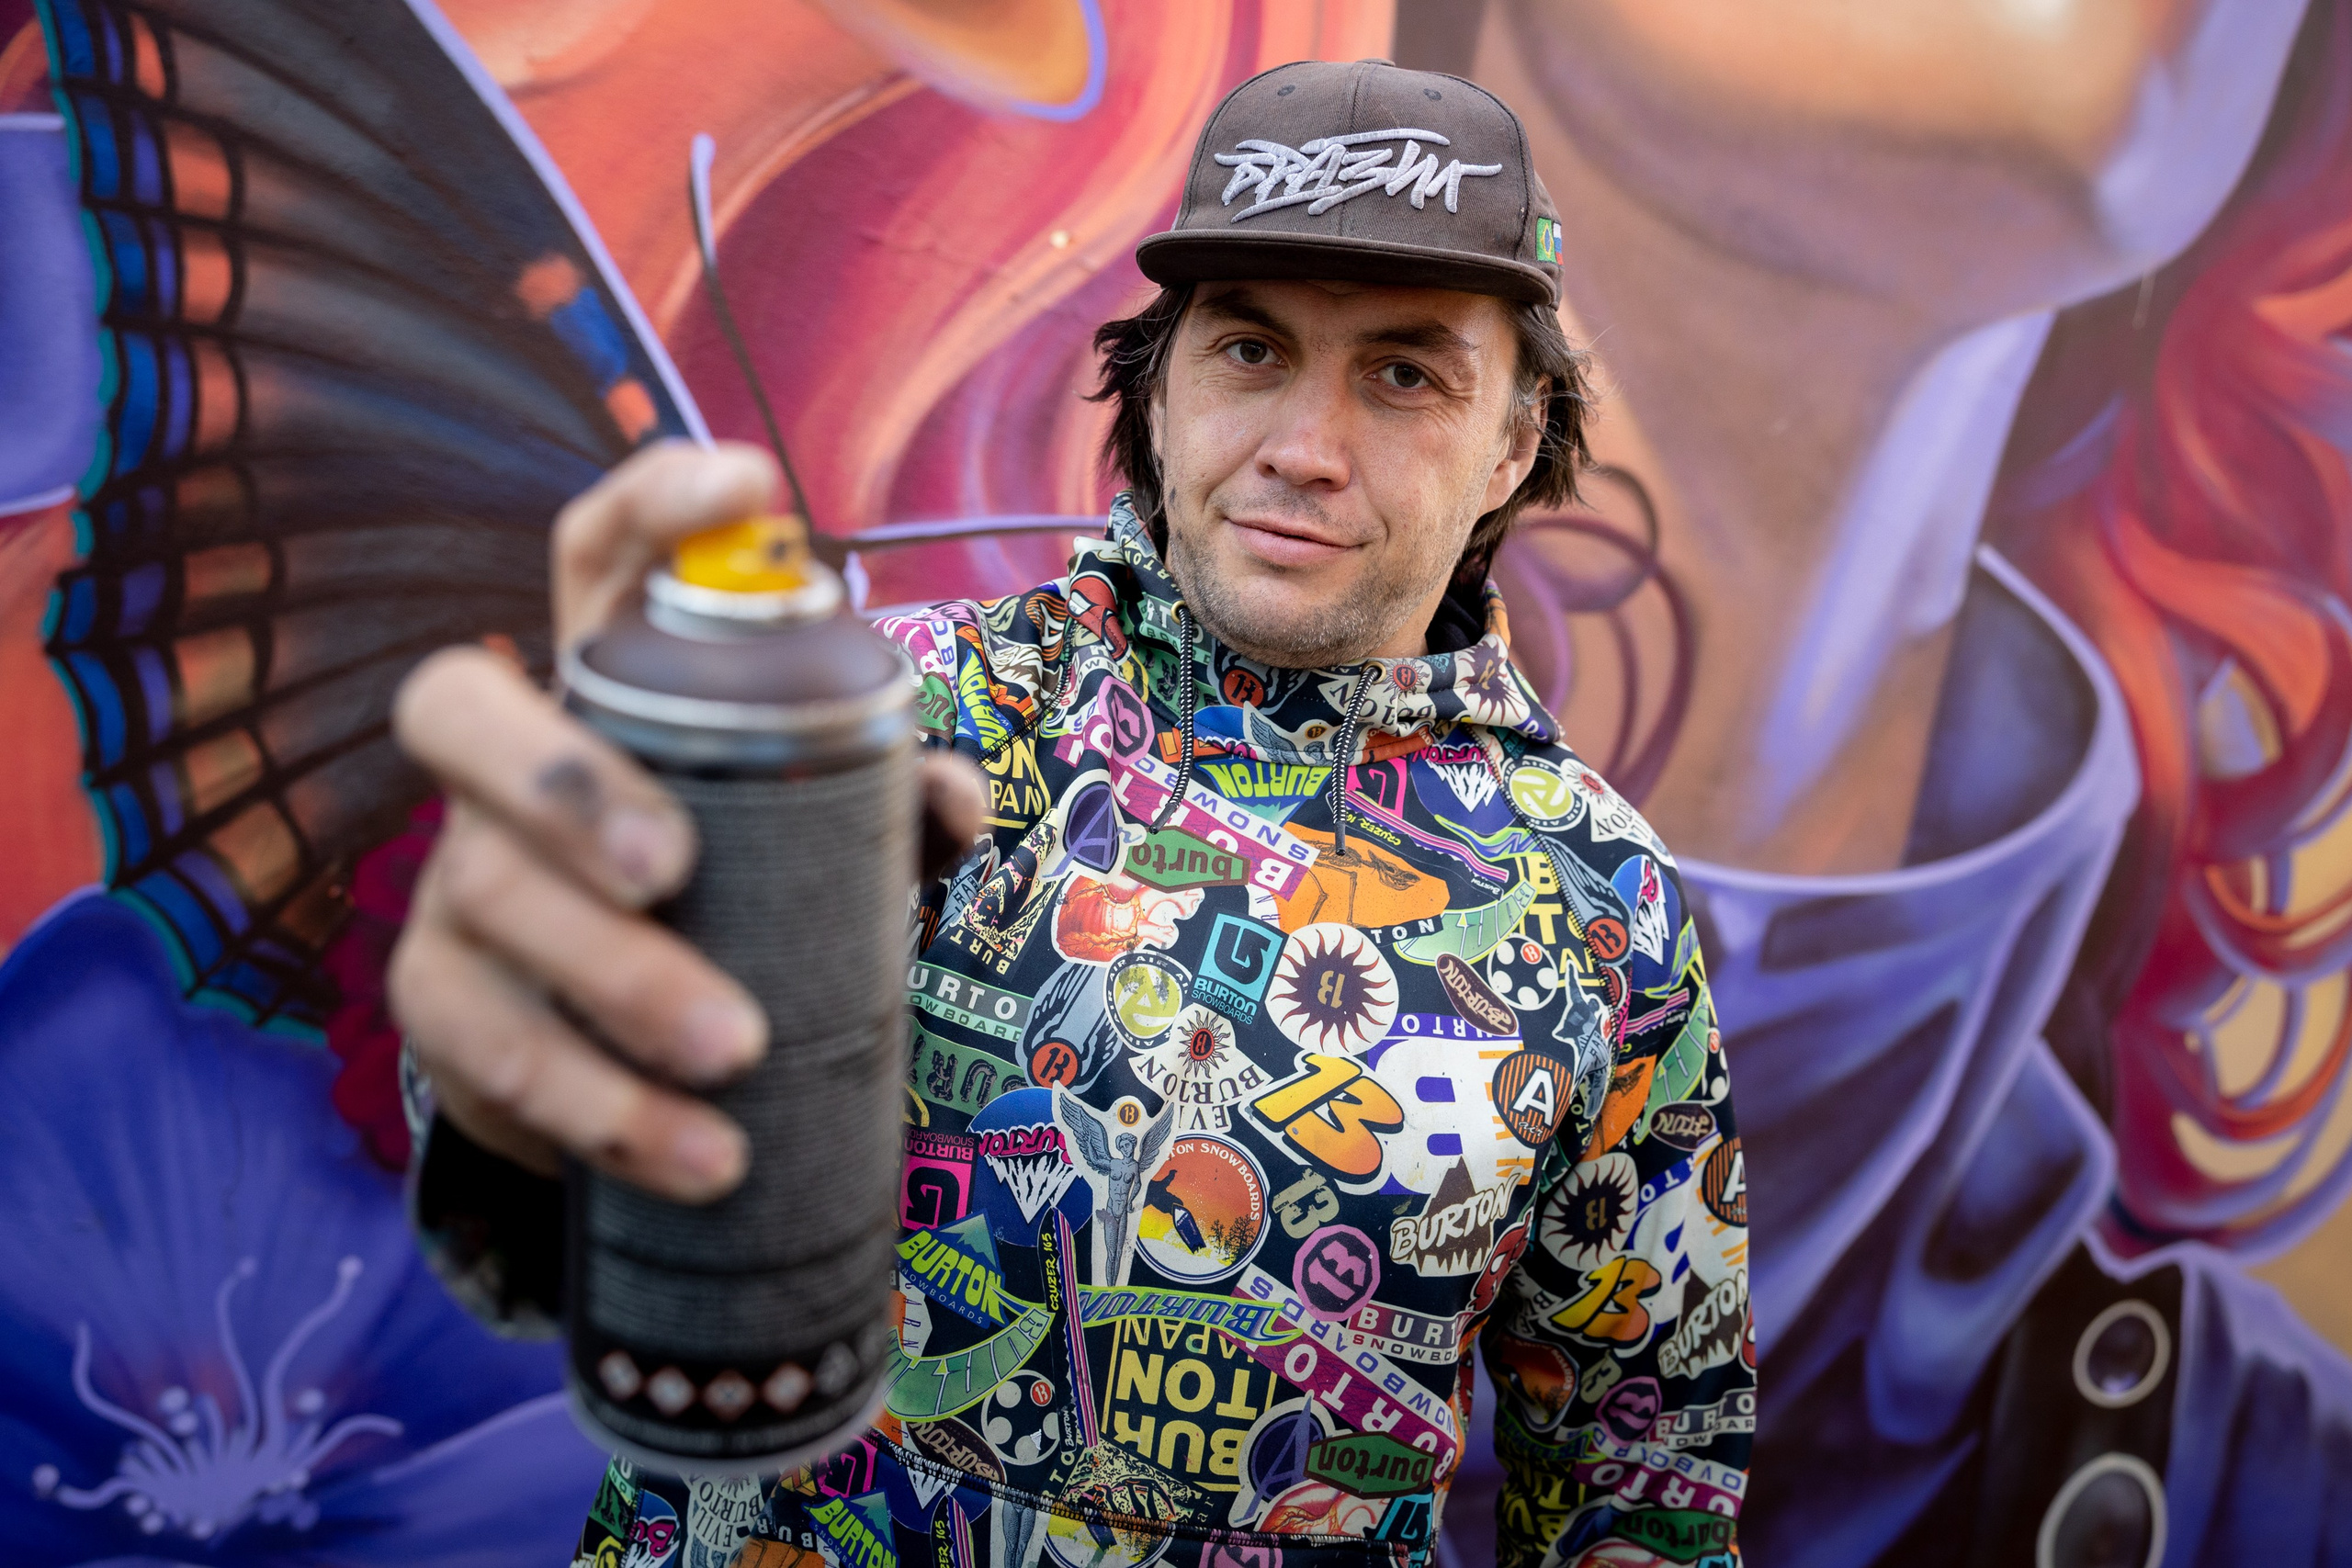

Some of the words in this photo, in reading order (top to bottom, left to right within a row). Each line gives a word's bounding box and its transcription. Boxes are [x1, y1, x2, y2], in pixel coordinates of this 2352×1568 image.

[1413, 744, 1483, 764] URTON
[989, 779, 1041, 816] PAN
[1200, 764, 1332, 798] BURTON
[1131, 843, 1236, 885] burto
[1471, 877, 1501, 895] BURTON
[1371, 919, 1435, 944] TON
[950, 930, 1010, 976] BURT
[906, 965, 1018, 1021] URTO
[1191, 990, 1254, 1026] SNOWBOARDS
[1193, 976, 1258, 1017] BURTON
[1039, 1047, 1071, 1084] 13
[1137, 1056, 1264, 1104] BURTON
[1124, 1105, 1136, 1122] 13
[1513, 1068, 1555, 1127] A
[1179, 1105, 1229, 1131] EVI
[1518, 1122, 1544, 1137] air
[904, 1138, 974, 1161] BURTON
[1168, 1143, 1194, 1160] TON
[1200, 1143, 1261, 1222] SNOWBOARDS
[1392, 1172, 1521, 1261] BURTON
[1043, 1233, 1053, 1251] 165
[897, 1259, 984, 1325] SNOWBOARDS
[898, 1230, 1009, 1326] BURTON
[1048, 1252, 1060, 1311] CRUZER
[1357, 1308, 1458, 1345] BURT
[1033, 1382, 1051, 1404] 13
[1115, 1349, 1259, 1420] TON
[1064, 1410, 1074, 1447] BURTON
[1284, 1344, 1455, 1483] BURTO
[1114, 1412, 1250, 1477] BUR
[1319, 1442, 1427, 1483] burton
[695, 1506, 734, 1549] EVIL
[934, 1520, 944, 1540] 165
